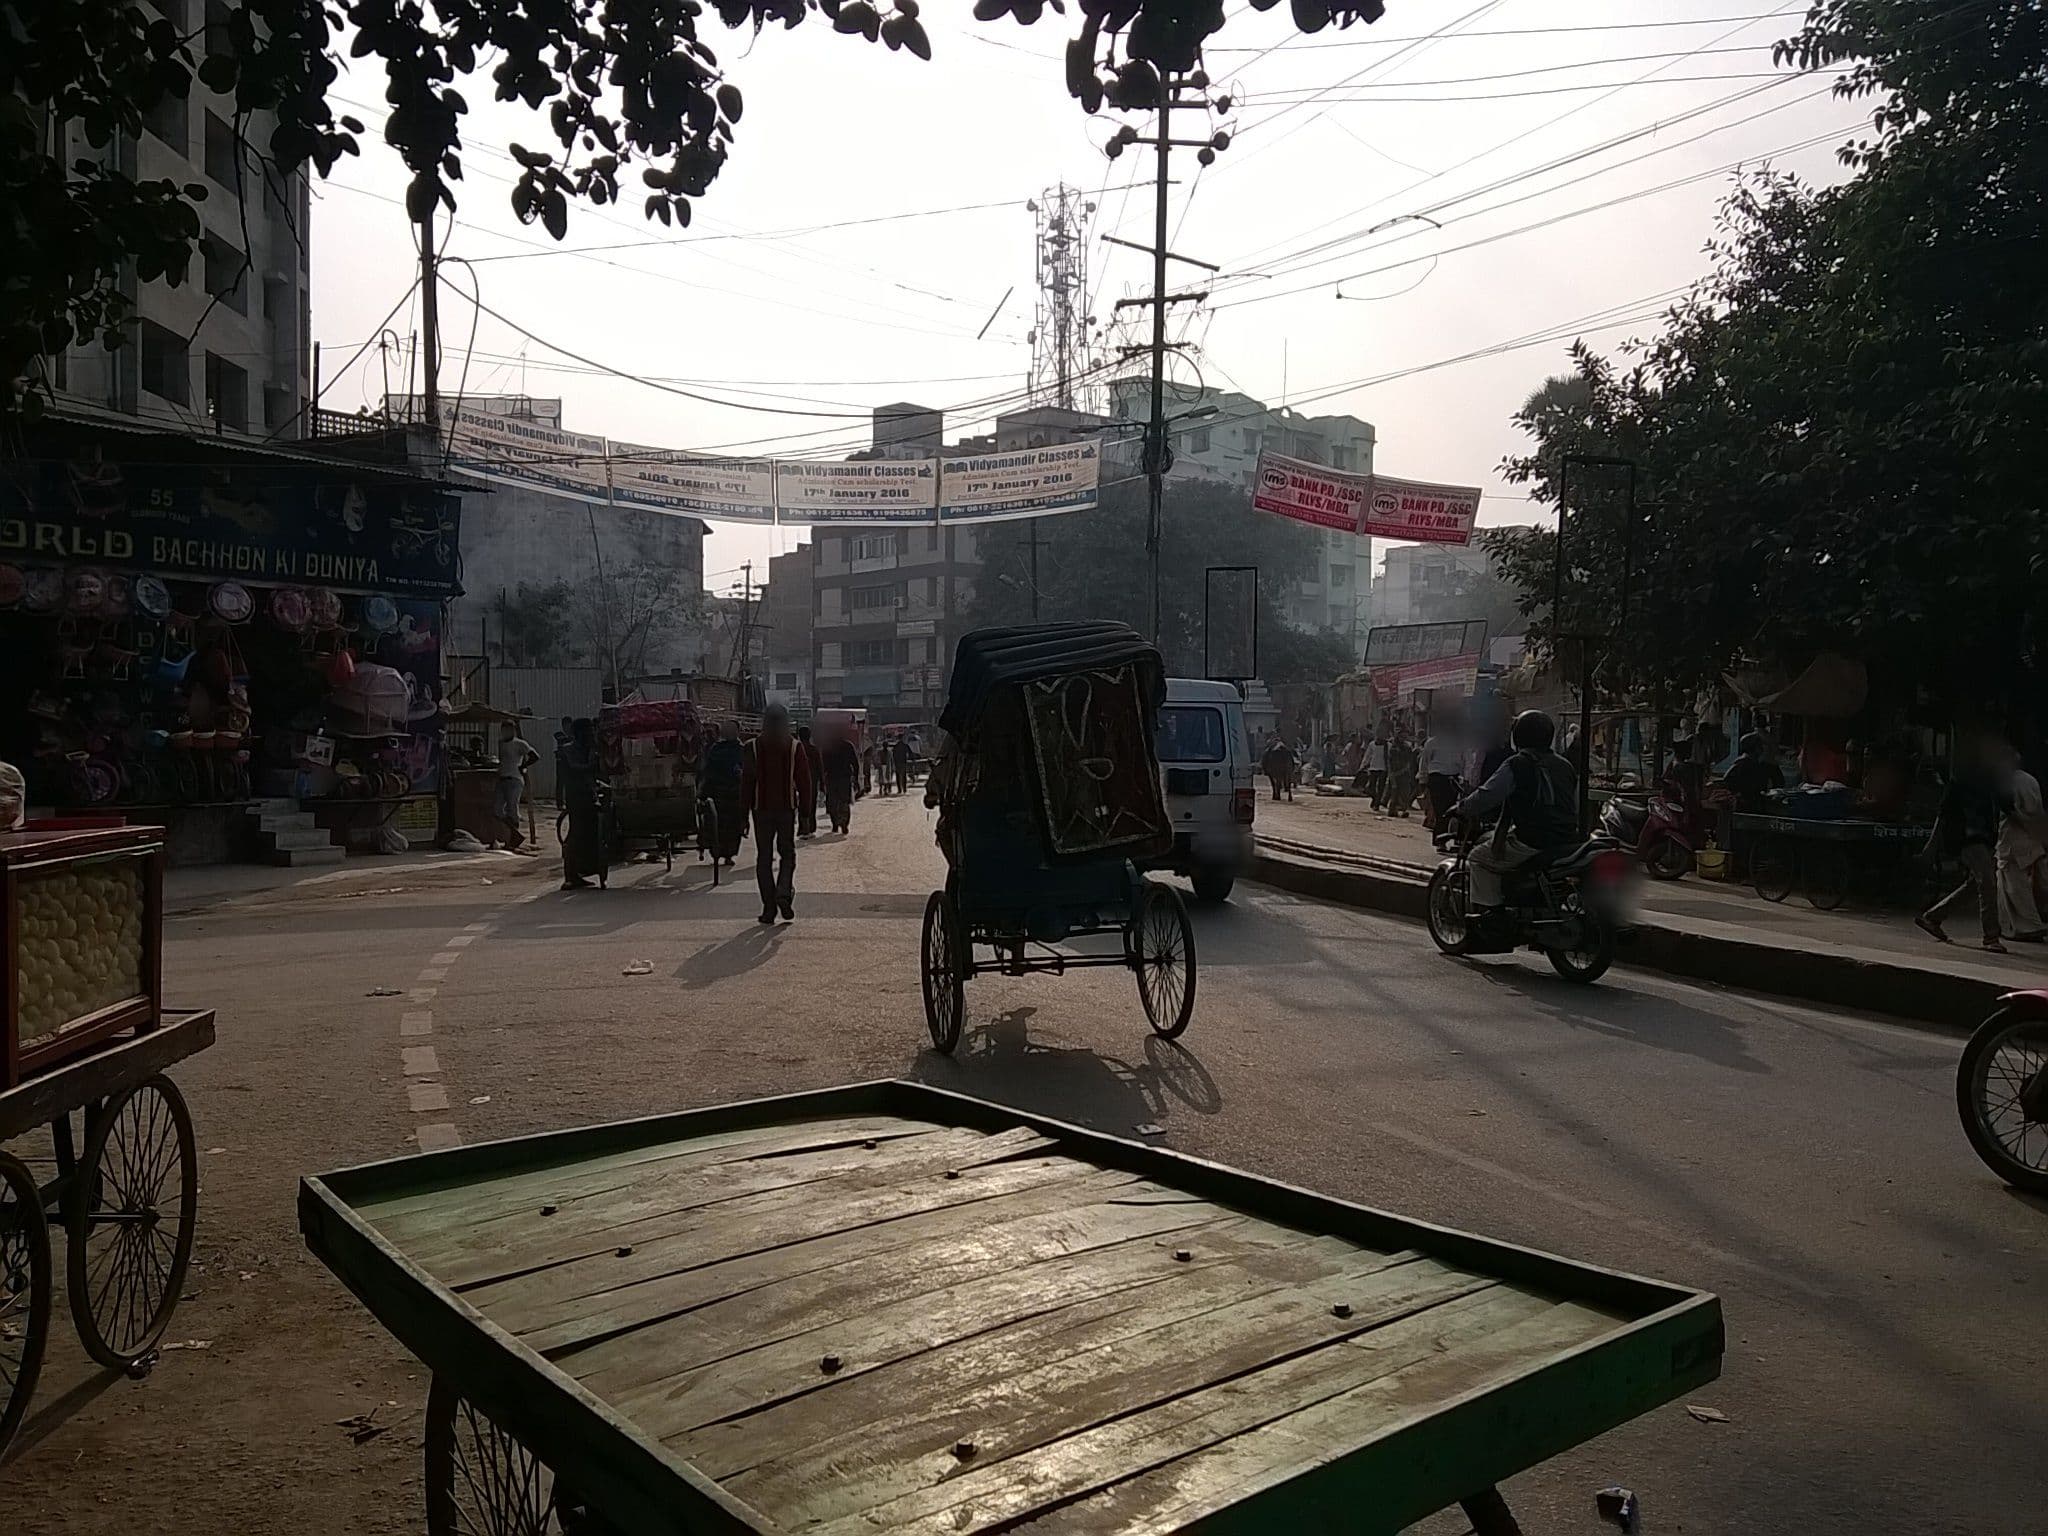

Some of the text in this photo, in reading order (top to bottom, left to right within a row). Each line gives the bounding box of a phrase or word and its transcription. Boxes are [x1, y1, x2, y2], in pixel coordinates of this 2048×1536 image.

[969, 448, 1080, 472] Vidyamandir Classes
[804, 465, 917, 477] Vidyamandir Classes
[1263, 472, 1286, 486] ims
[967, 472, 1073, 493] 17th January 2016
[1291, 475, 1319, 493] BANK
[149, 487, 174, 506] 55
[803, 489, 910, 499] 17th January 2016
[1373, 498, 1395, 510] ims
[1401, 498, 1431, 512] BANK
[152, 535, 379, 583] BACHHON KI DUNIYA
